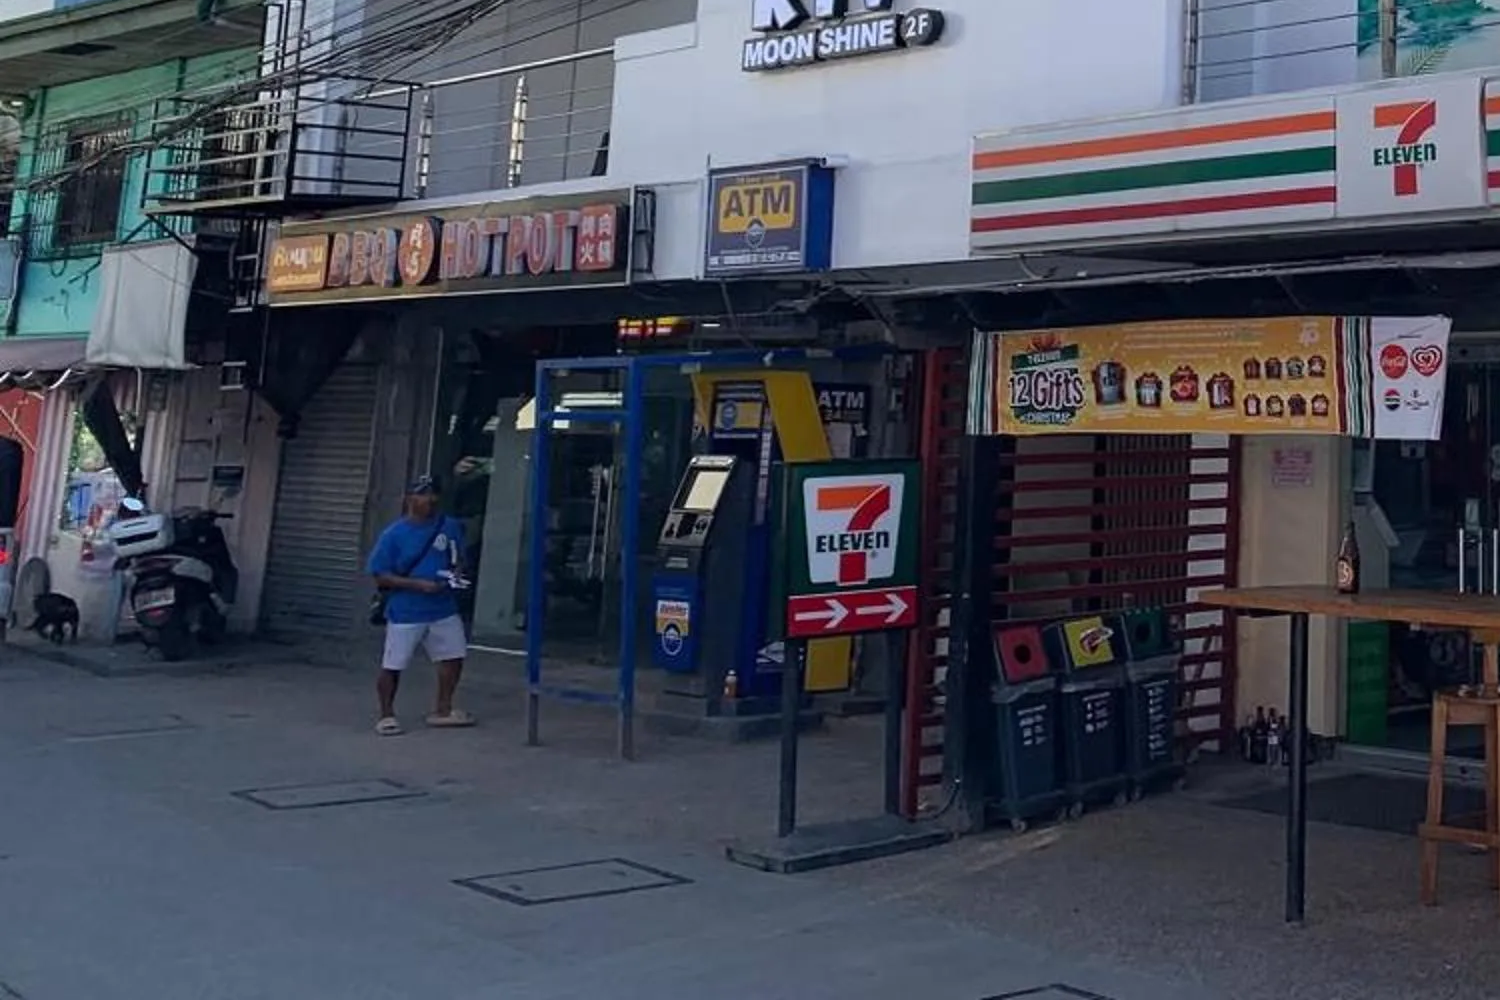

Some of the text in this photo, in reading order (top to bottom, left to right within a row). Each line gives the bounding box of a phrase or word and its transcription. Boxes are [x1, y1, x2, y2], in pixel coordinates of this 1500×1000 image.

[744, 13, 929, 67] MOON SHINE 2F
[1374, 100, 1436, 196] 7
[722, 184, 791, 219] ATM
[328, 226, 397, 288] BBQ
[439, 209, 581, 280] HOTPOT
[818, 390, 865, 410] ATM
[1009, 367, 1086, 411] 12 Gifts
[817, 484, 891, 583] 7
